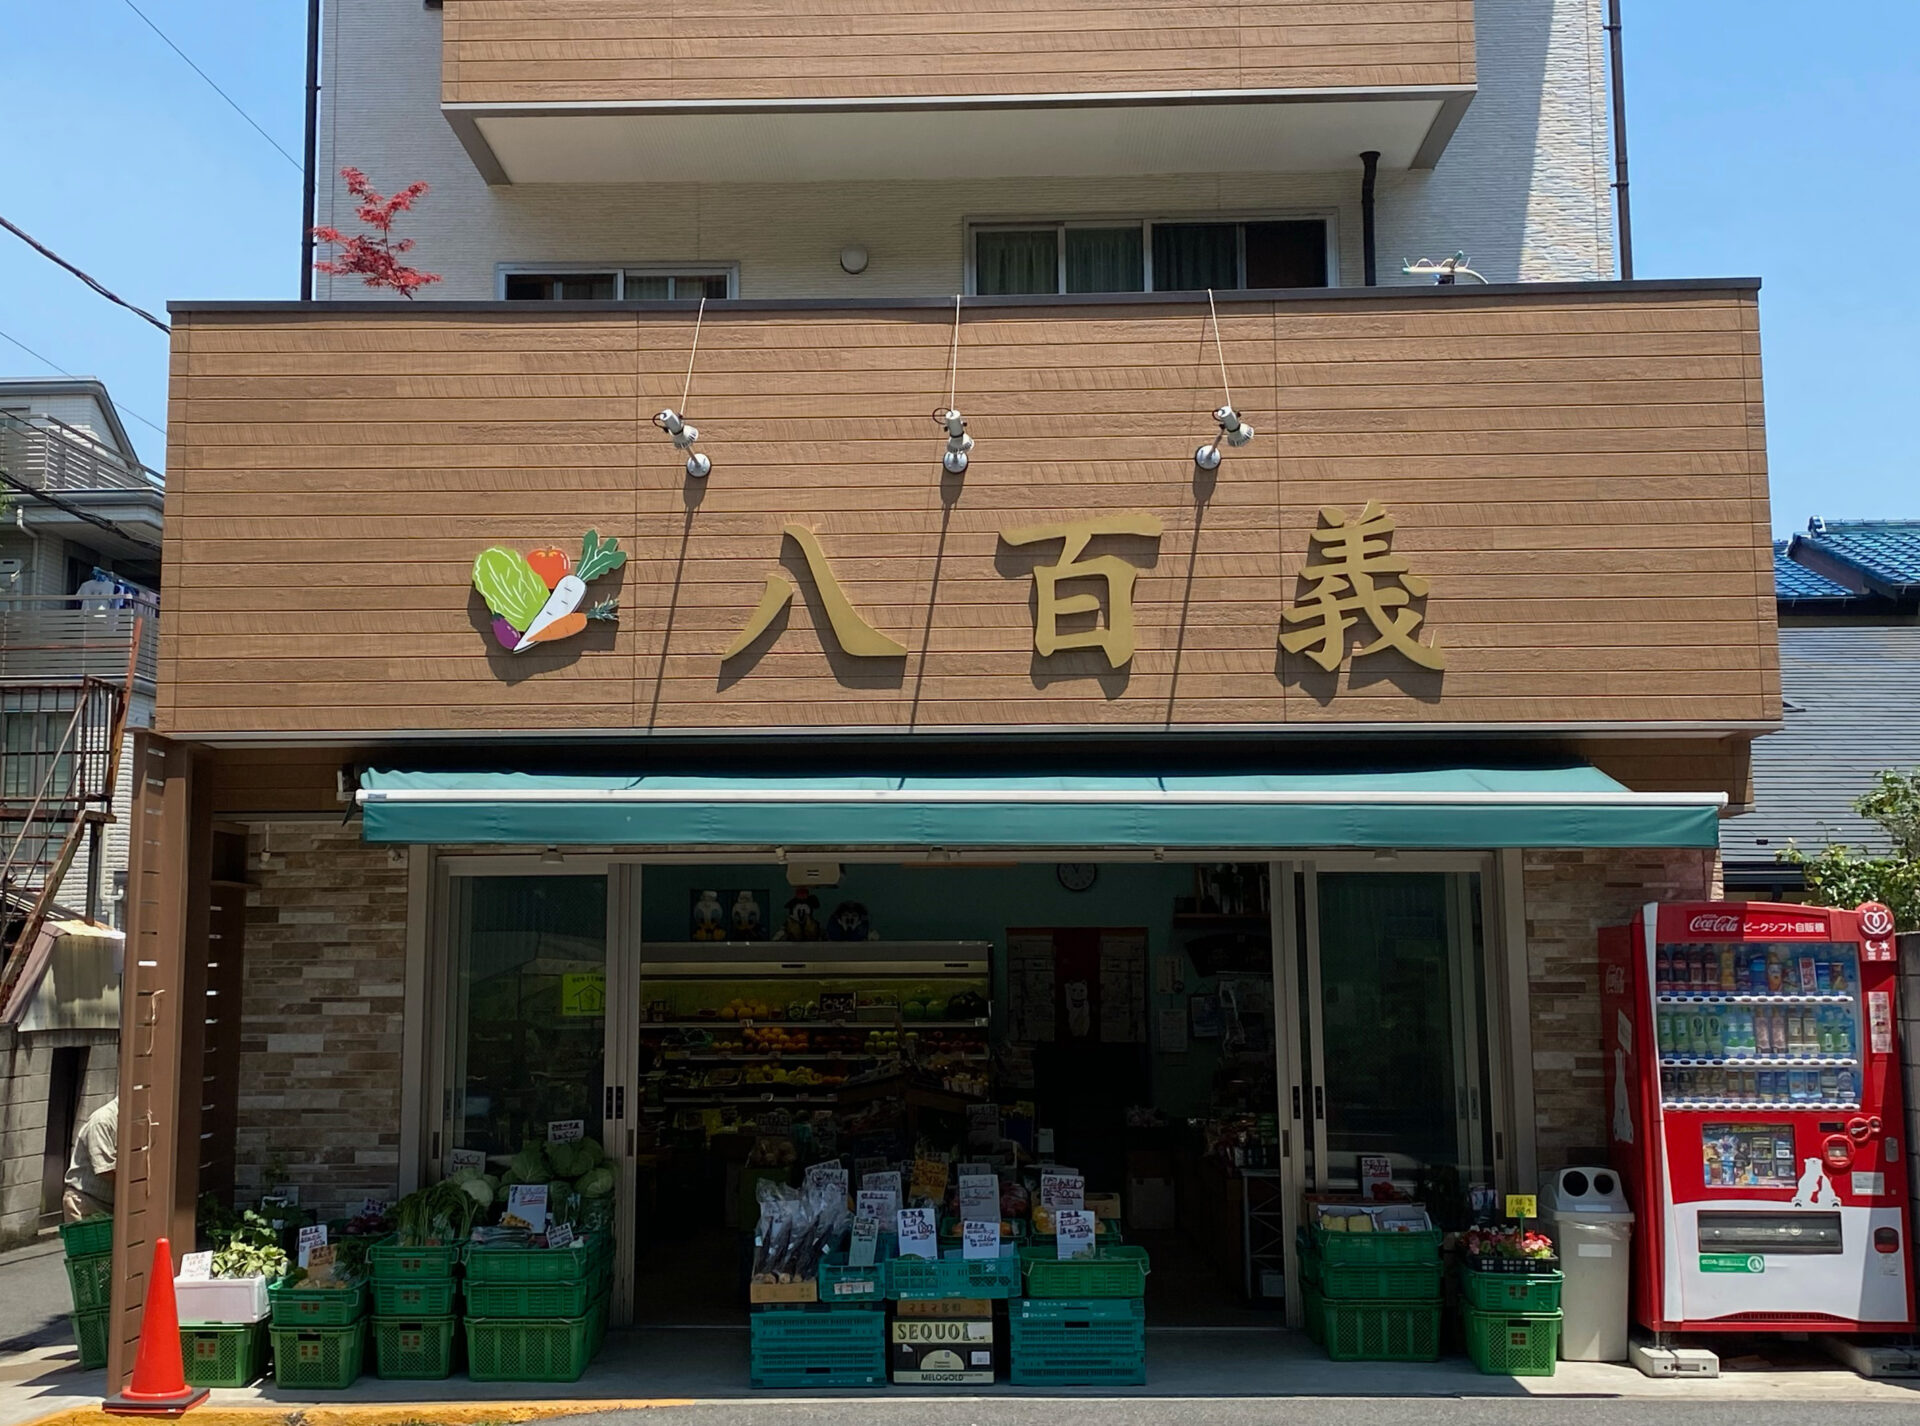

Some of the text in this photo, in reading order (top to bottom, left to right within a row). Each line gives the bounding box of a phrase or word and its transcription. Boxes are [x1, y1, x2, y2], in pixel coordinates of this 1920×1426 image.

[722, 499, 1445, 672] 八百義
[897, 1323, 972, 1343] SEQUOI
[921, 1373, 964, 1381] MELOGOLD
